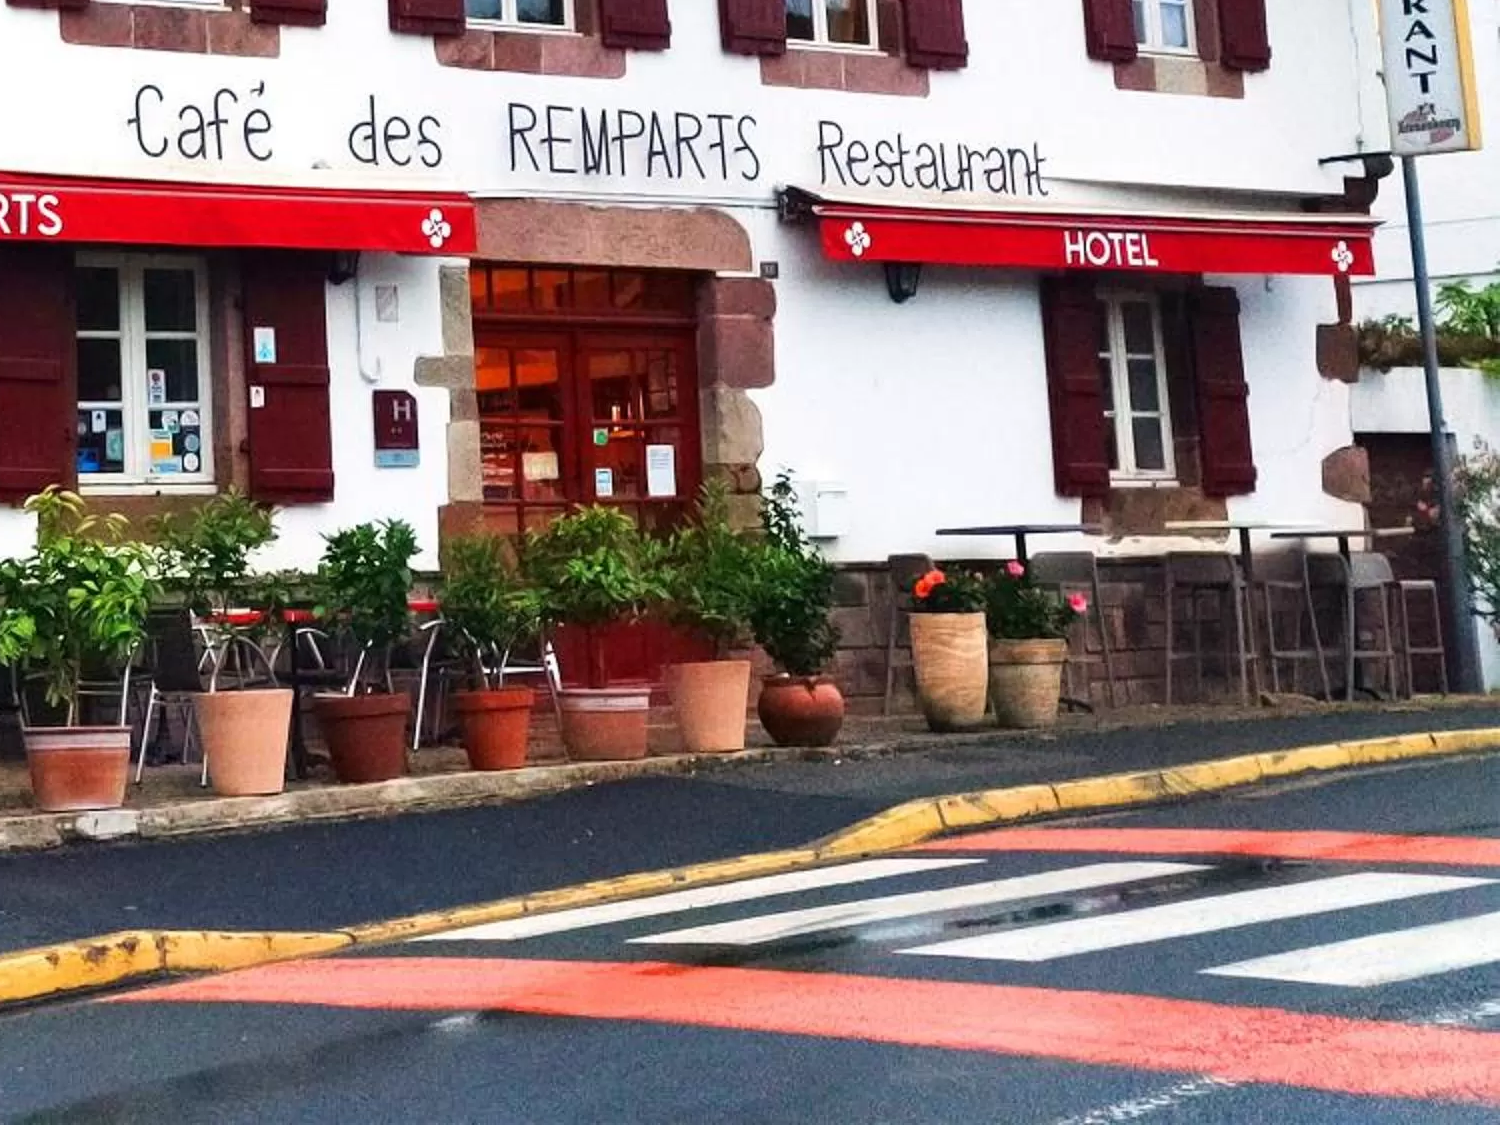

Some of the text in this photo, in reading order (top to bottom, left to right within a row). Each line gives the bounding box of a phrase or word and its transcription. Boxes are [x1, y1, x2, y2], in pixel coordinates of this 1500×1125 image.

[127, 80, 1050, 196] Café des REMPARTS Restaurant
[1063, 230, 1159, 267] HOTEL
[393, 399, 411, 422] H
